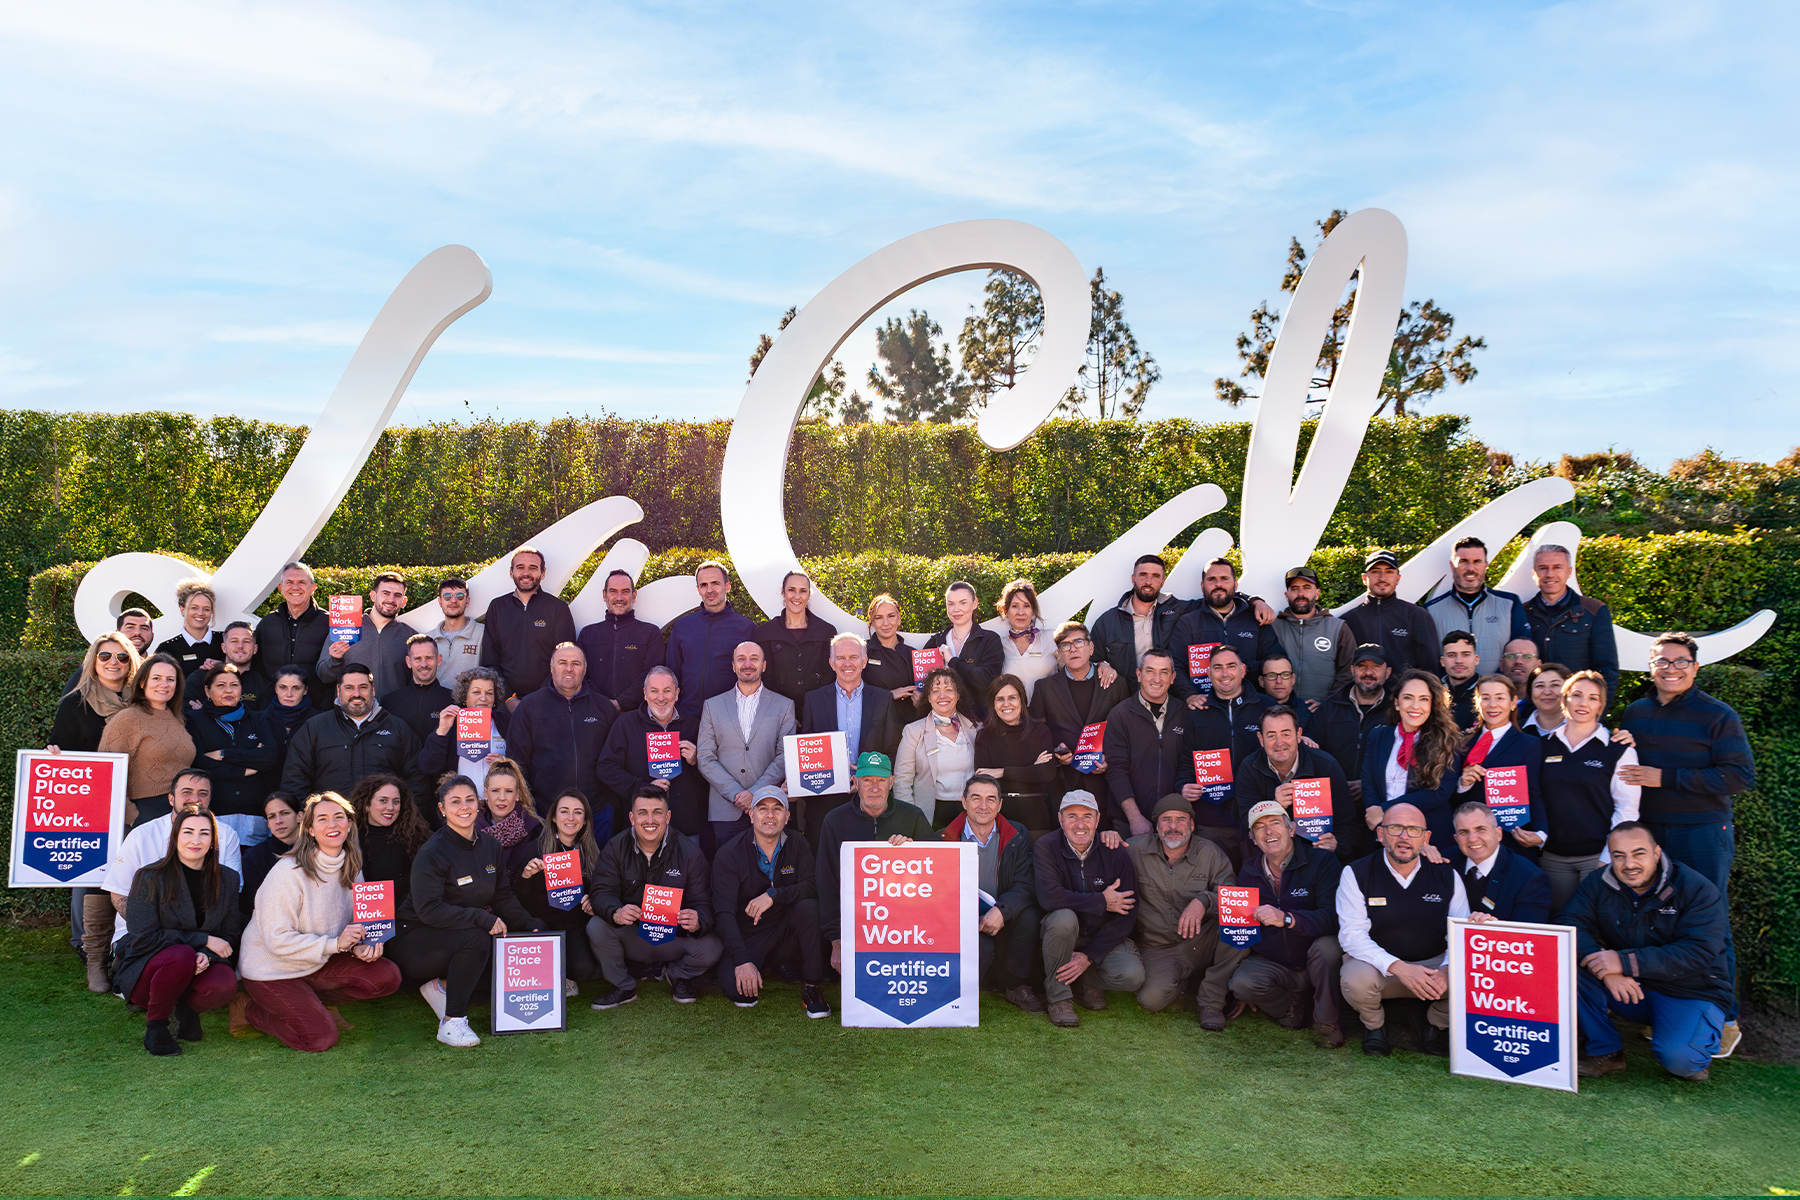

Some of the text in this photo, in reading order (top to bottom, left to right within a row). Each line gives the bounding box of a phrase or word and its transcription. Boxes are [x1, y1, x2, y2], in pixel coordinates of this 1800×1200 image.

[331, 596, 354, 604] Great
[1084, 724, 1101, 732] Great
[1081, 731, 1098, 739] Place
[798, 739, 823, 747] Great
[1195, 752, 1221, 760] Great
[1196, 760, 1221, 768] Place
[35, 763, 93, 779] Great
[803, 772, 831, 780] Certified
[1486, 768, 1517, 778] Great
[35, 779, 91, 795] Place
[1487, 778, 1517, 787] Place
[1295, 788, 1321, 797] Place
[1488, 787, 1500, 795] To
[33, 796, 55, 810] To
[1295, 798, 1306, 806] To
[1297, 818, 1330, 827] Certified
[33, 837, 101, 849] Certified
[49, 851, 83, 862] 2025
[545, 853, 571, 863] Great
[546, 862, 572, 871] Place
[861, 854, 933, 875] Great
[547, 871, 558, 879] To
[354, 883, 384, 892] Great
[551, 887, 581, 898] Certified
[646, 887, 674, 898] Great
[863, 878, 933, 898] Place
[355, 892, 384, 901] Place
[1220, 888, 1249, 898] Great
[645, 895, 672, 906] Place
[1221, 897, 1249, 907] Place
[355, 902, 367, 910] To
[644, 903, 655, 912] To
[1220, 906, 1232, 914] To
[861, 902, 889, 921] To
[364, 922, 392, 931] ertified
[642, 923, 674, 934] Certified
[1223, 927, 1257, 935] Certified
[507, 944, 541, 955] Great
[1469, 934, 1535, 956] Great
[508, 955, 541, 965] Place
[1471, 953, 1534, 975] Place
[507, 966, 520, 976] To
[865, 960, 950, 977] Certified
[1470, 972, 1495, 990] To
[887, 980, 928, 995] 2025
[508, 993, 549, 1003] Certified
[1474, 1020, 1550, 1043] Certified
[1493, 1039, 1530, 1055] 2025
[1503, 1055, 1520, 1063] ESP
